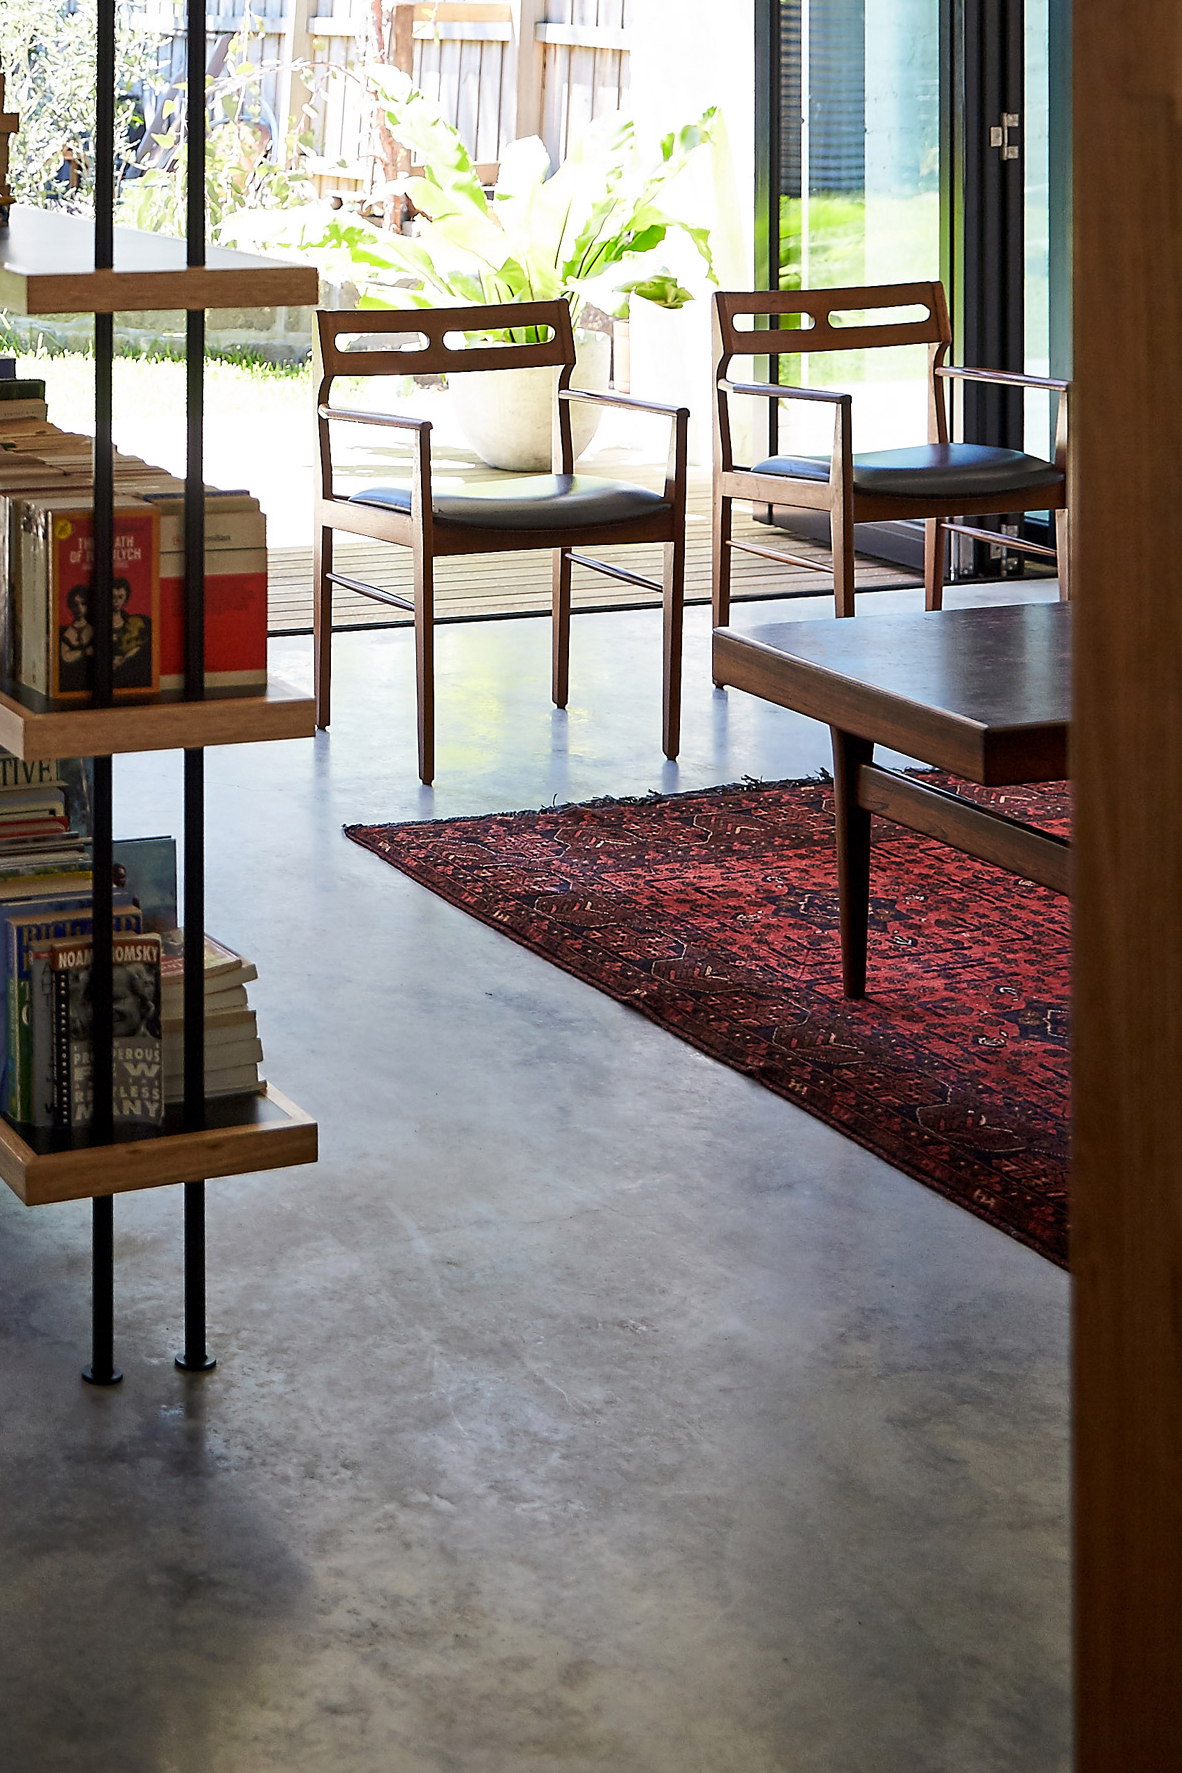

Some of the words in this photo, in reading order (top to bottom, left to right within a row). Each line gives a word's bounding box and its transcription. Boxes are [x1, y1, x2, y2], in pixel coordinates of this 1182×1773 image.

[112, 945, 158, 963] OMSKY
[74, 1047, 160, 1065] PREROUS
[74, 1061, 161, 1081] FW
[74, 1086, 160, 1103] RELESS
